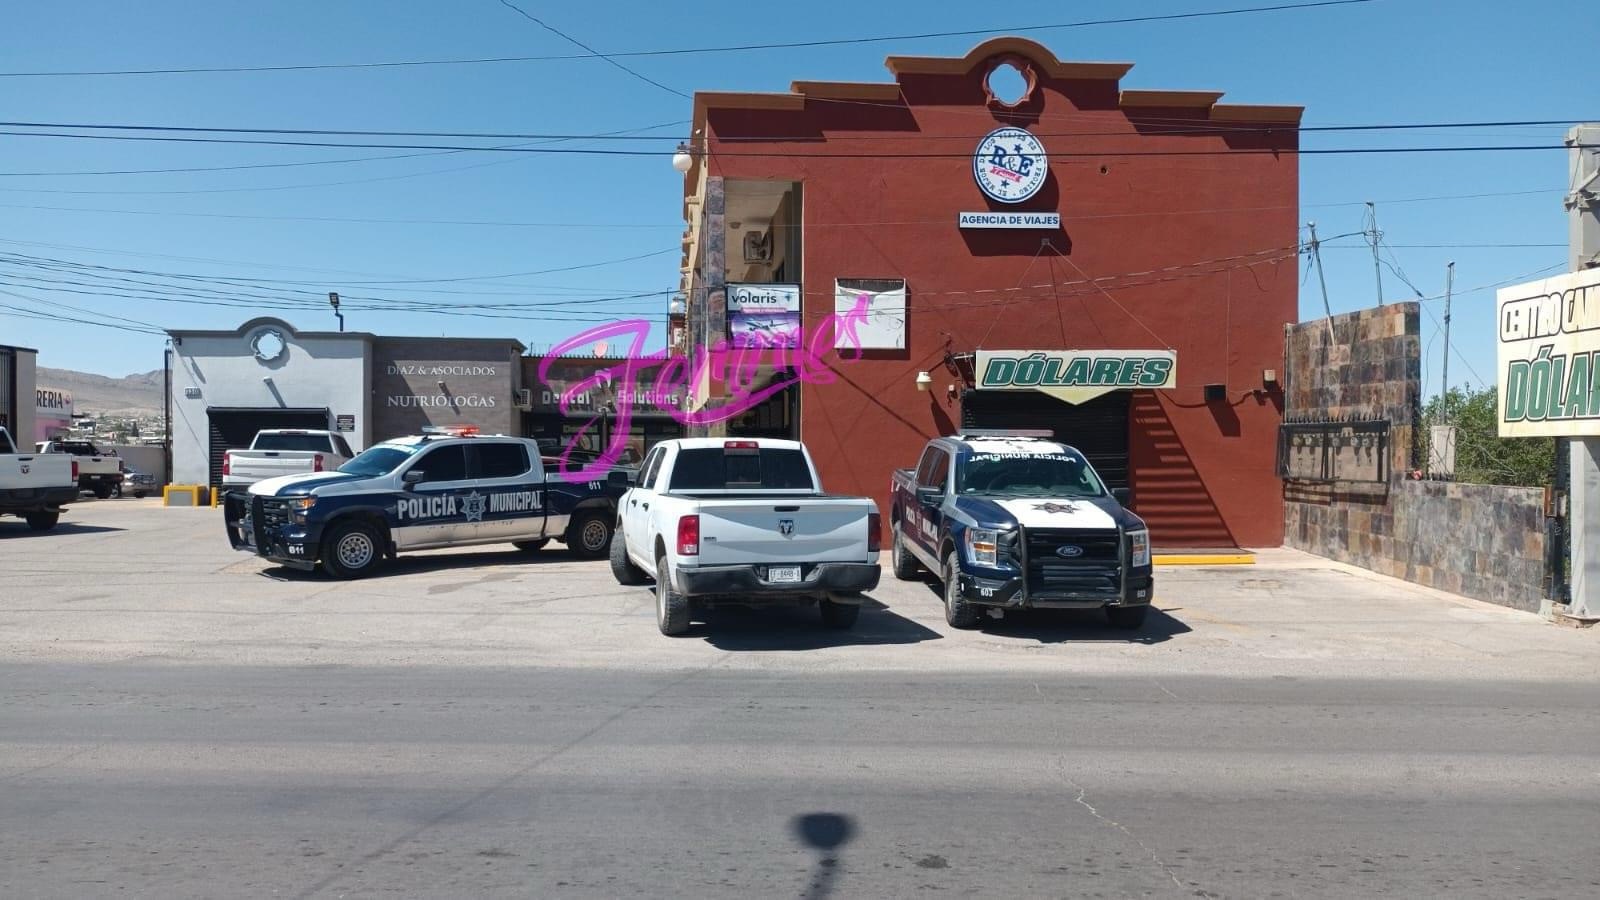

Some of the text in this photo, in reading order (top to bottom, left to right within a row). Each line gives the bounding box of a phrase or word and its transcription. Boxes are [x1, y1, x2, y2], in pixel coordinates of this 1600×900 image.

[961, 216, 1059, 225] AGENCIA DE VIAJES
[731, 292, 777, 304] volaris
[1500, 291, 1562, 342] CENTRO
[418, 366, 426, 375] &
[431, 366, 495, 376] ASOCIADOS
[982, 353, 1173, 388] DÓLARES
[388, 393, 496, 408] NUTRIÓLOGAS
[617, 391, 679, 405] Solutions
[398, 491, 543, 520] POLICÍA MUNICIPAL
